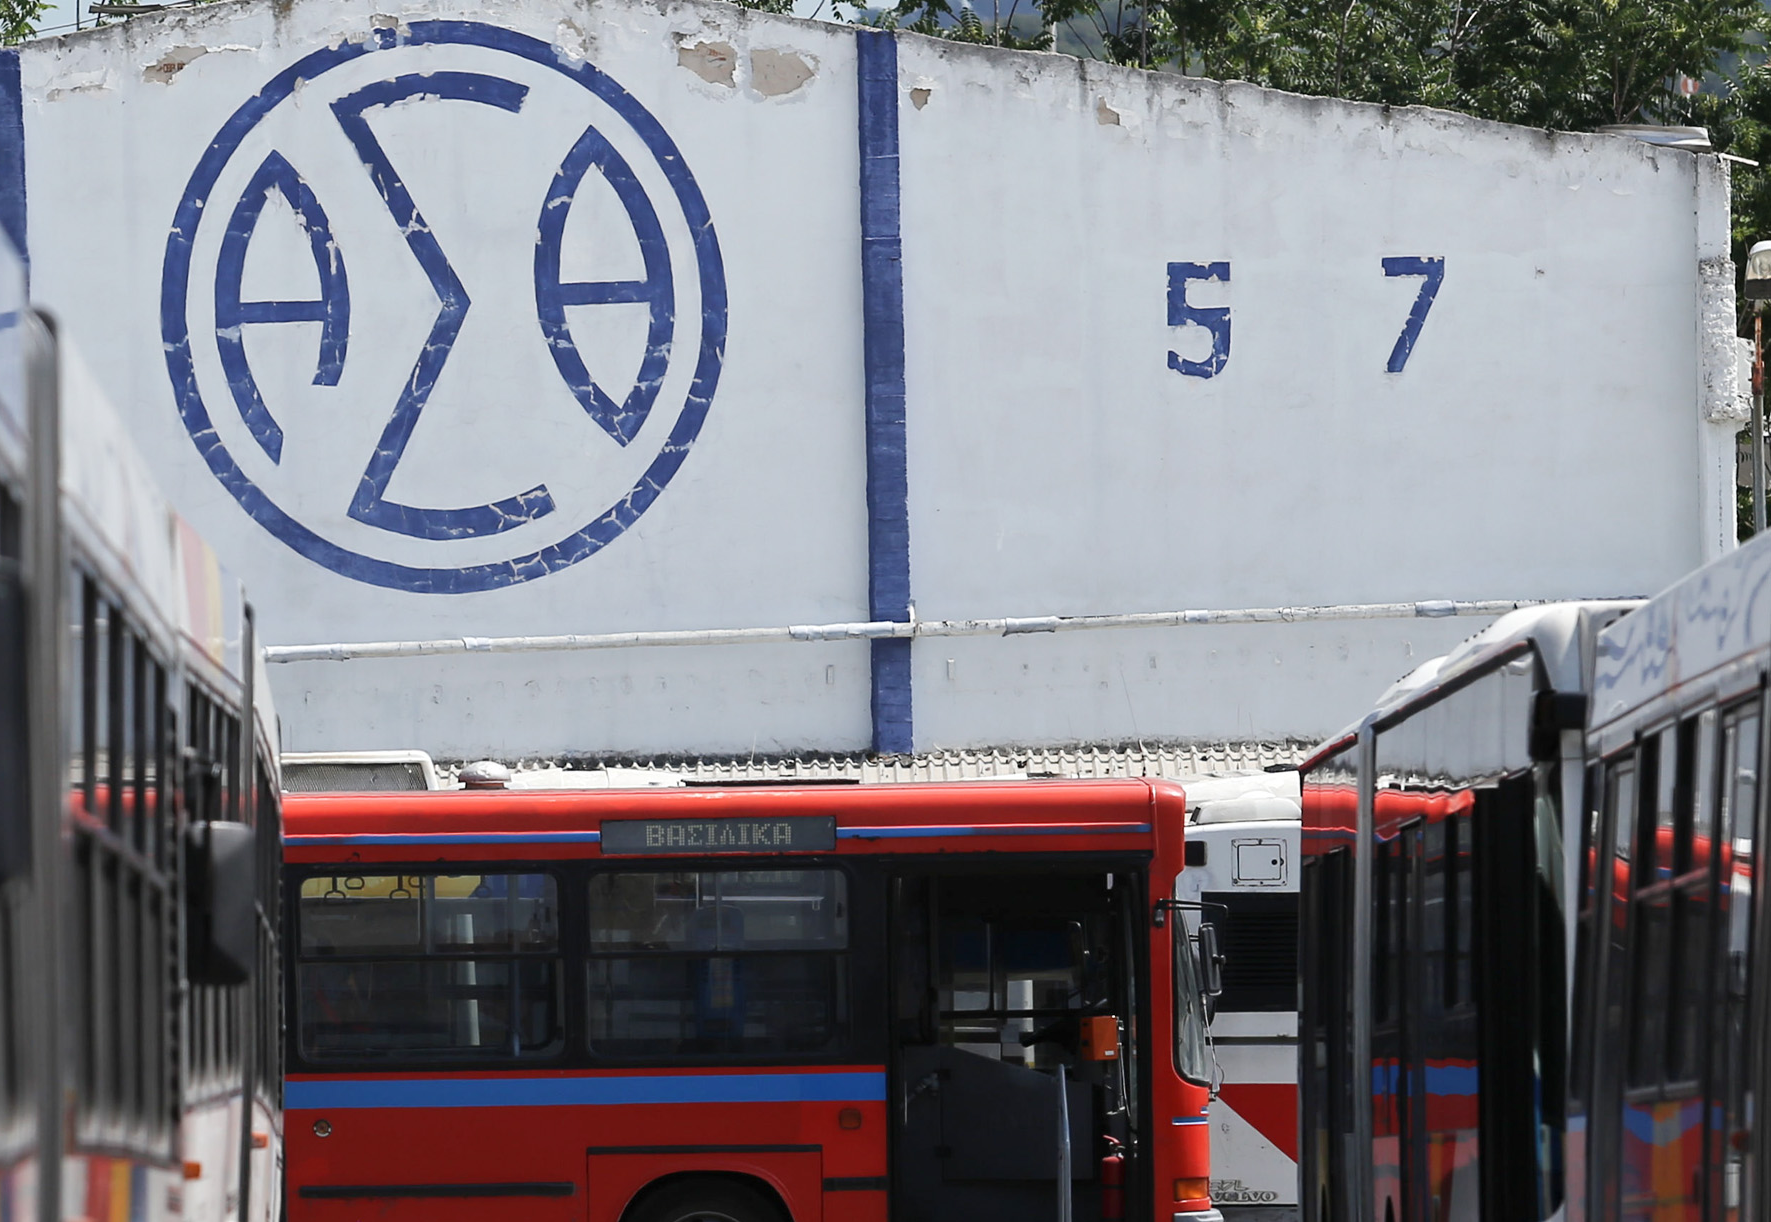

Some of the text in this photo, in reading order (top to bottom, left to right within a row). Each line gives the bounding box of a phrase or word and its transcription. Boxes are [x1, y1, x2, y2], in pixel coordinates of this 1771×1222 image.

[1167, 257, 1445, 379] 5 7
[646, 823, 792, 847] ΒΑΣΙΛΙΚΑ
[1210, 1191, 1278, 1202] VOLVO
